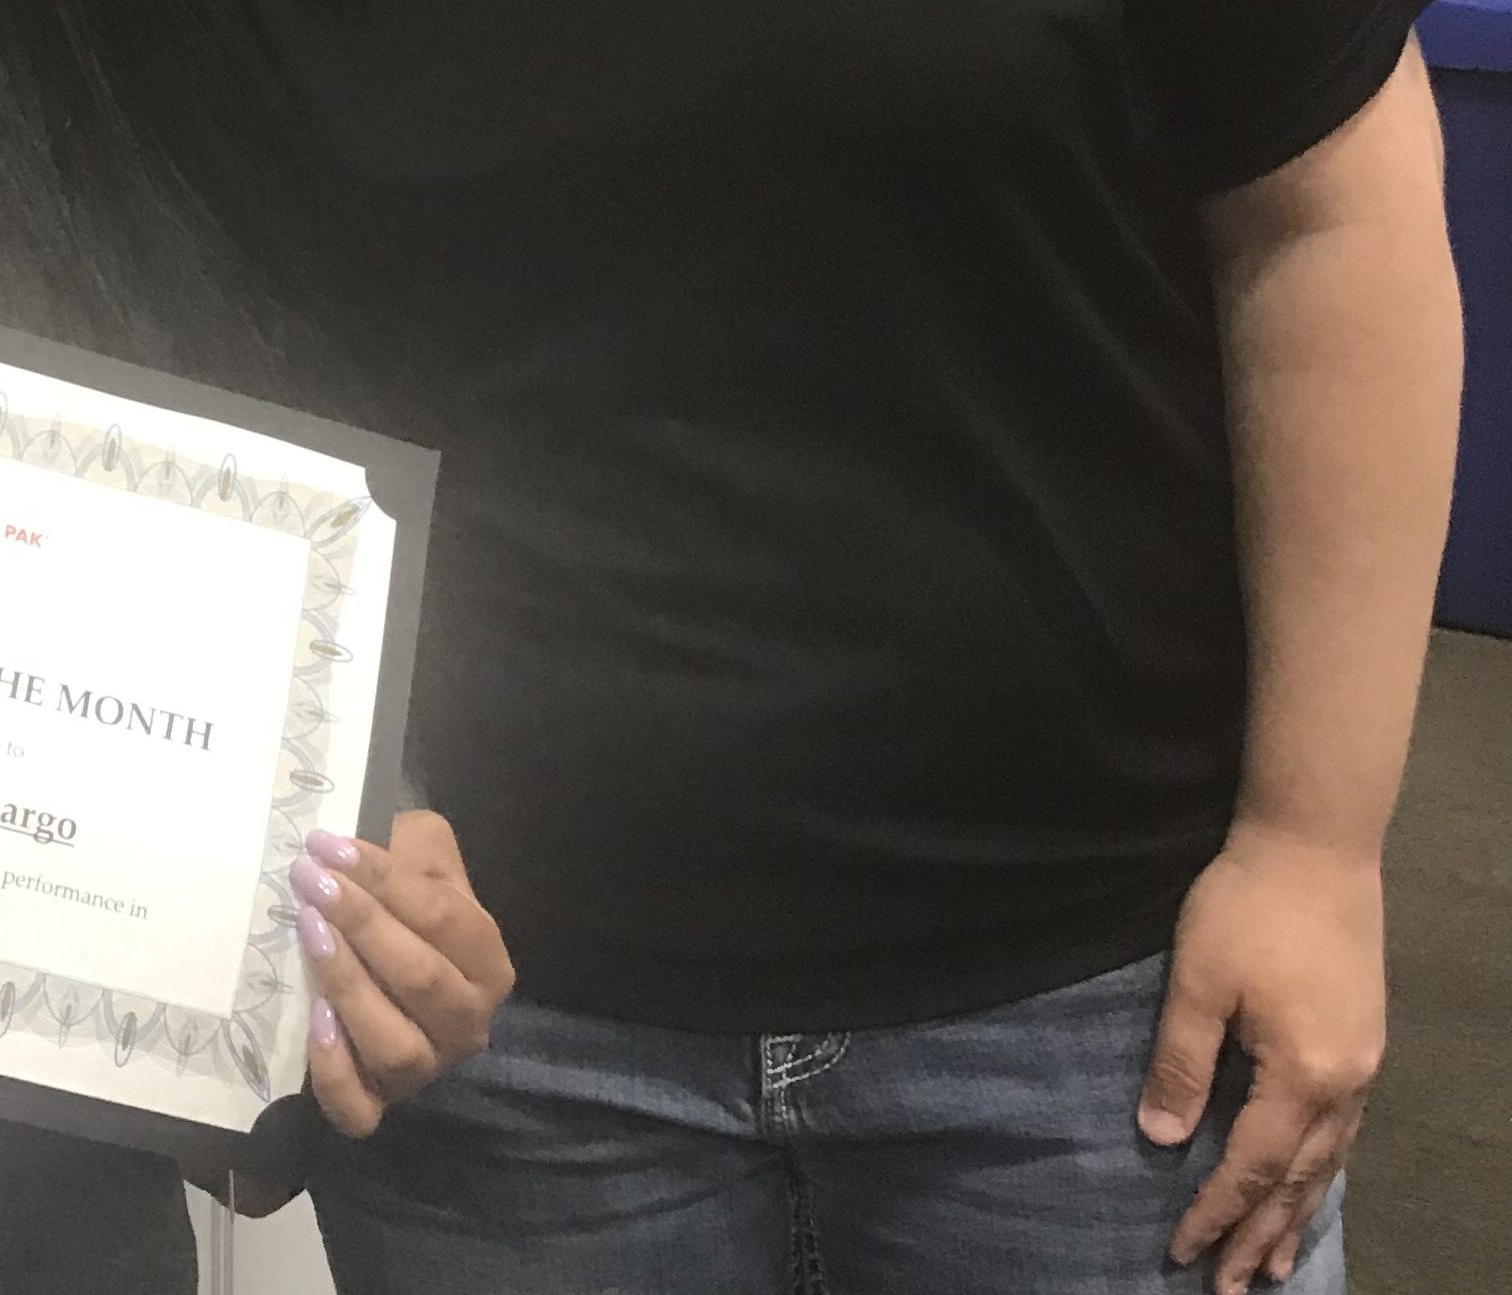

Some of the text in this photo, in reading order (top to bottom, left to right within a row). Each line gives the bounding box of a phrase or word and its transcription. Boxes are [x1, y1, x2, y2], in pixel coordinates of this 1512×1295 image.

[4, 524, 43, 548] PAK
[55, 682, 216, 752] MONTH
[0, 740, 25, 760] to
[0, 866, 126, 914] performance
[128, 900, 149, 921] in
